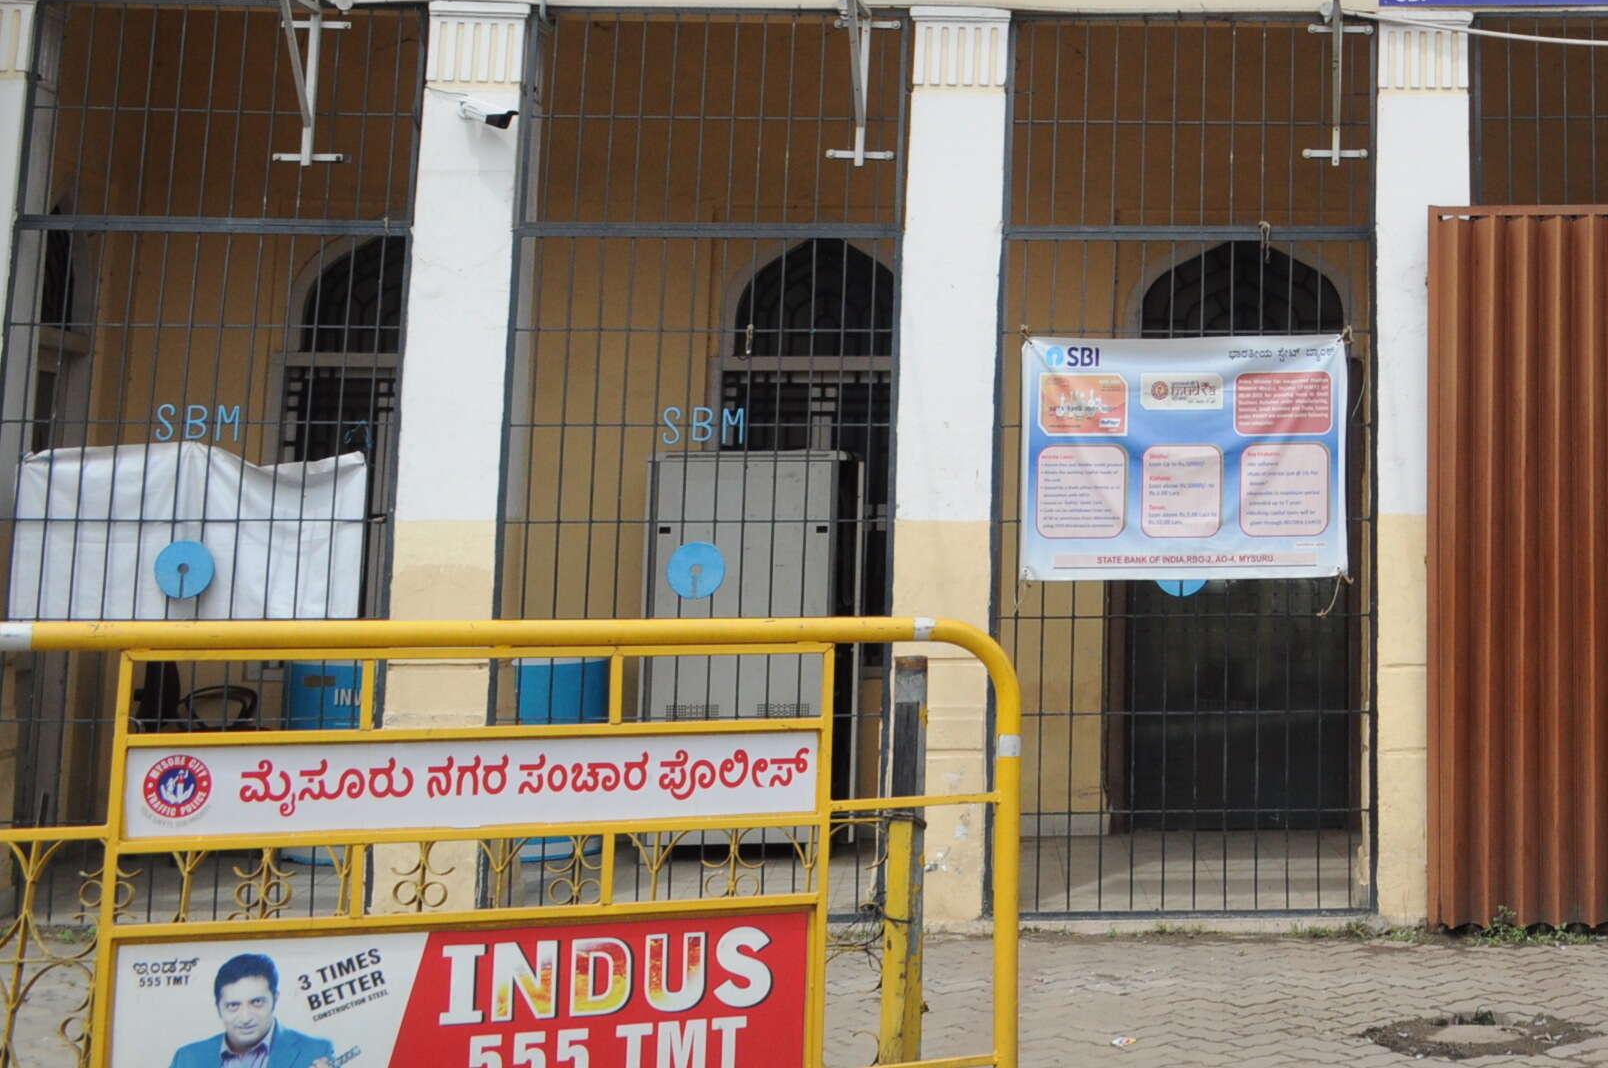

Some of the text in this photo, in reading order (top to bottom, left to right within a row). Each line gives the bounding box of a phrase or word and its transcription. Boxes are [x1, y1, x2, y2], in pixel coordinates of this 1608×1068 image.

[1067, 347, 1099, 366] SBI
[155, 403, 243, 443] SBM
[662, 406, 747, 446] SBM
[239, 758, 413, 818] ಮೈಸೂರು
[427, 754, 509, 798] ನಗರ
[518, 751, 649, 795] ಸಂಚಾರ
[139, 974, 190, 988] 555 TMT
[298, 948, 382, 990] 3 TIMES
[439, 926, 771, 1025] INDUS
[307, 970, 386, 1010] BETTER
[312, 990, 388, 1022] CONSTRUCTION STEEL
[469, 1016, 747, 1068] 555 TMT
